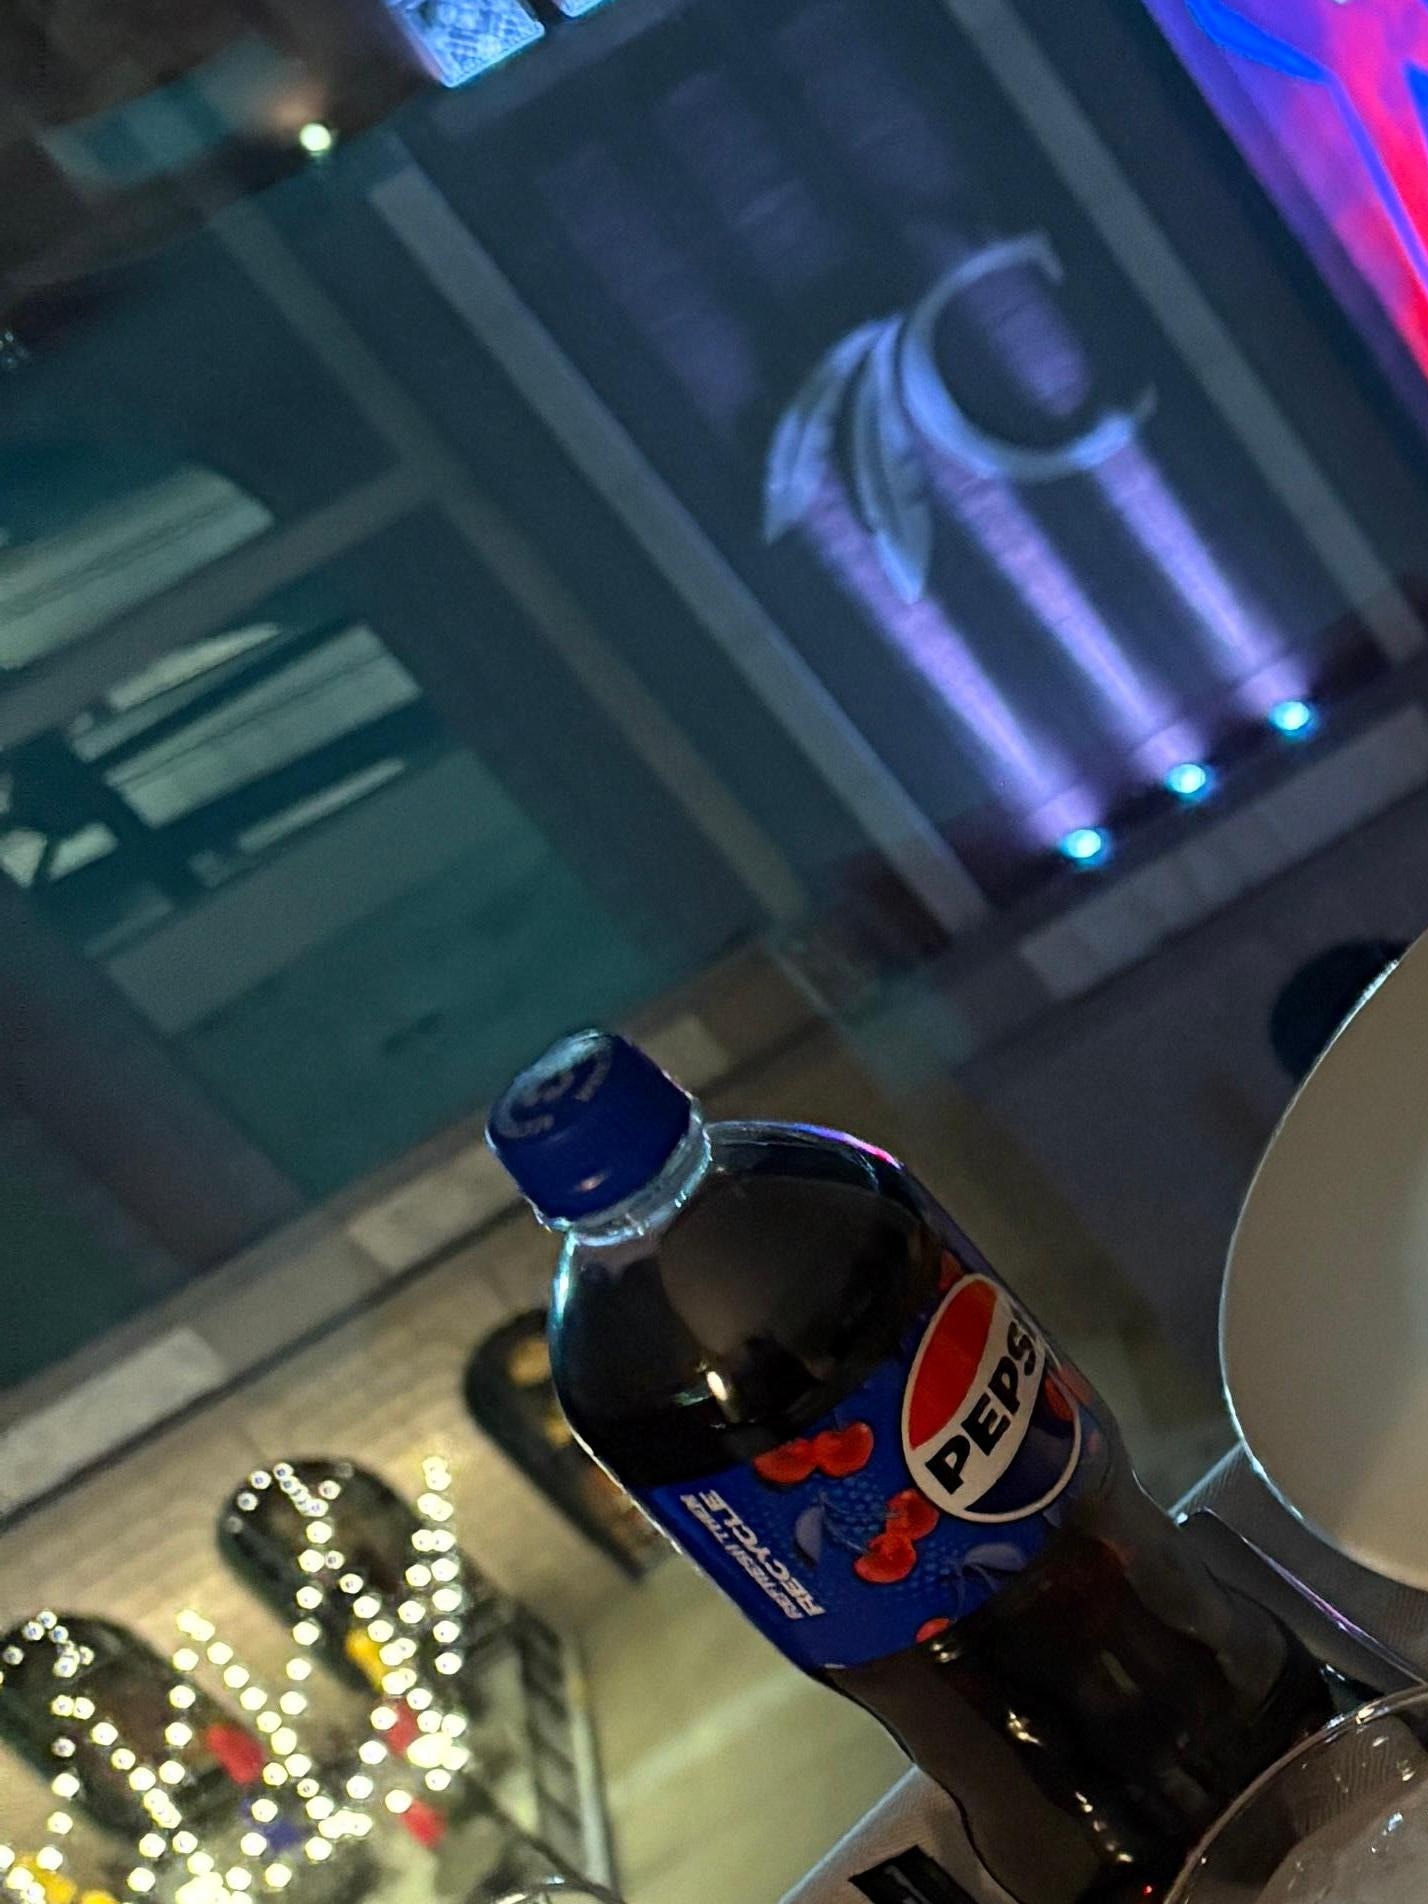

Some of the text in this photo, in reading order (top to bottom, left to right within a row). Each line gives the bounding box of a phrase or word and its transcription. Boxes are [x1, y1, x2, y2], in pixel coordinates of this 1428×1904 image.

[679, 1494, 805, 1620] REFRESH THEN
[698, 1489, 827, 1617] RECYCLE
